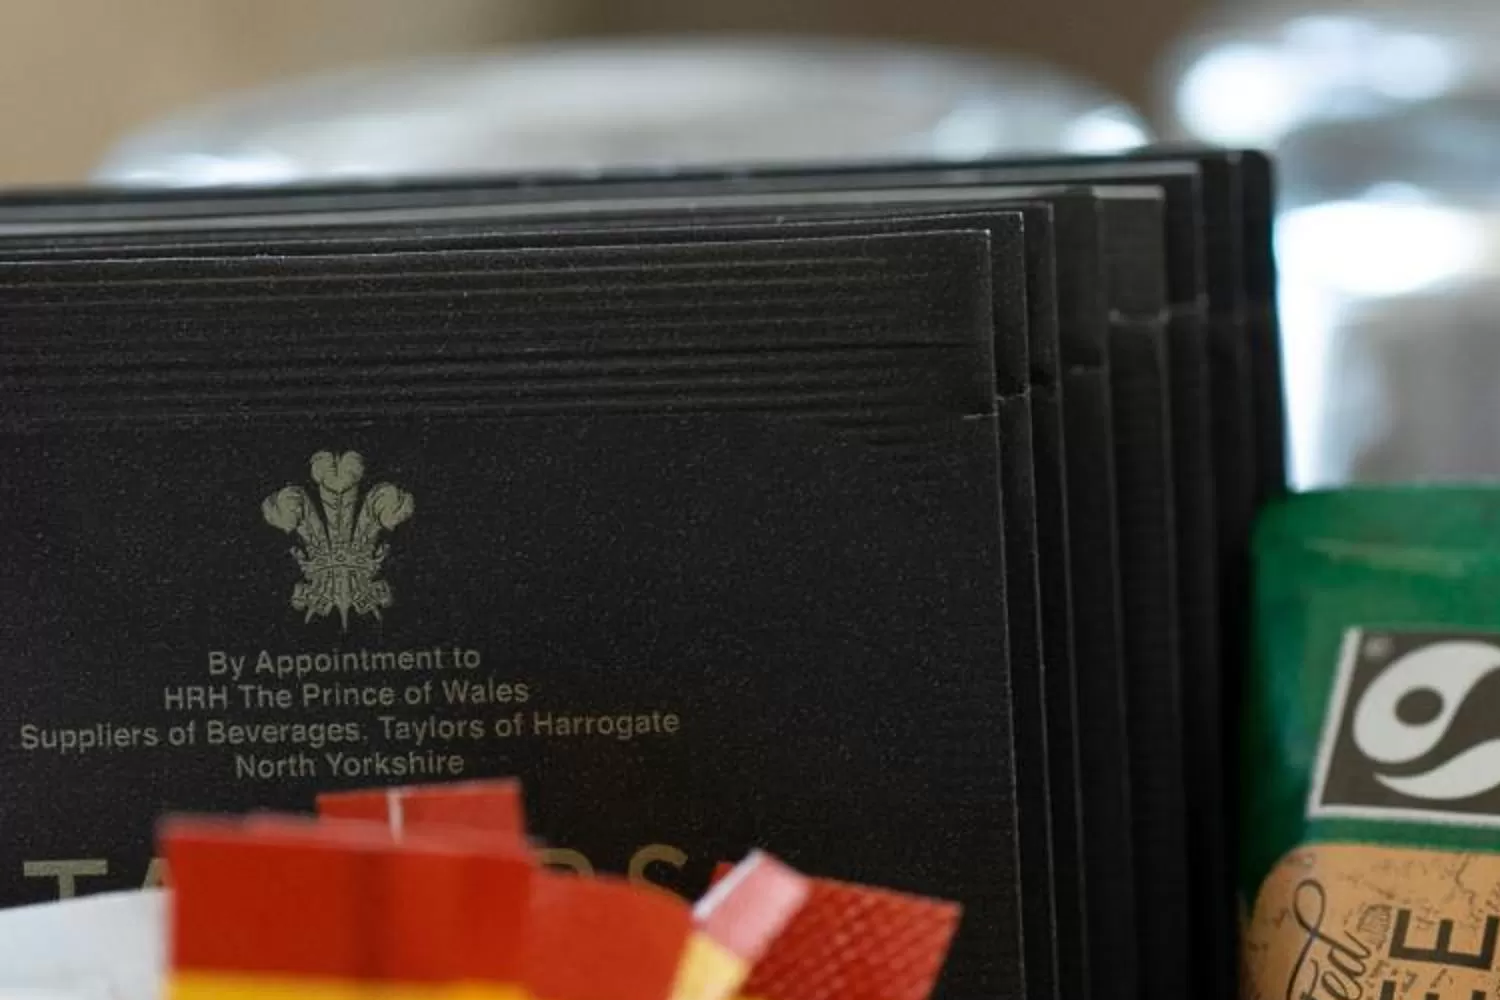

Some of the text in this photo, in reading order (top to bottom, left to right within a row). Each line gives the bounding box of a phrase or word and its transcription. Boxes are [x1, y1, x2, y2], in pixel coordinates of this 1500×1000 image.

[208, 646, 481, 681] By Appointment to
[163, 677, 530, 711] HRH The Prince of Wales
[20, 721, 159, 753] Suppliers
[168, 719, 197, 747] of
[377, 714, 486, 746] Taylors
[495, 711, 524, 738] of
[533, 710, 682, 741] Harrogate
[235, 748, 466, 780] North Yorkshire
